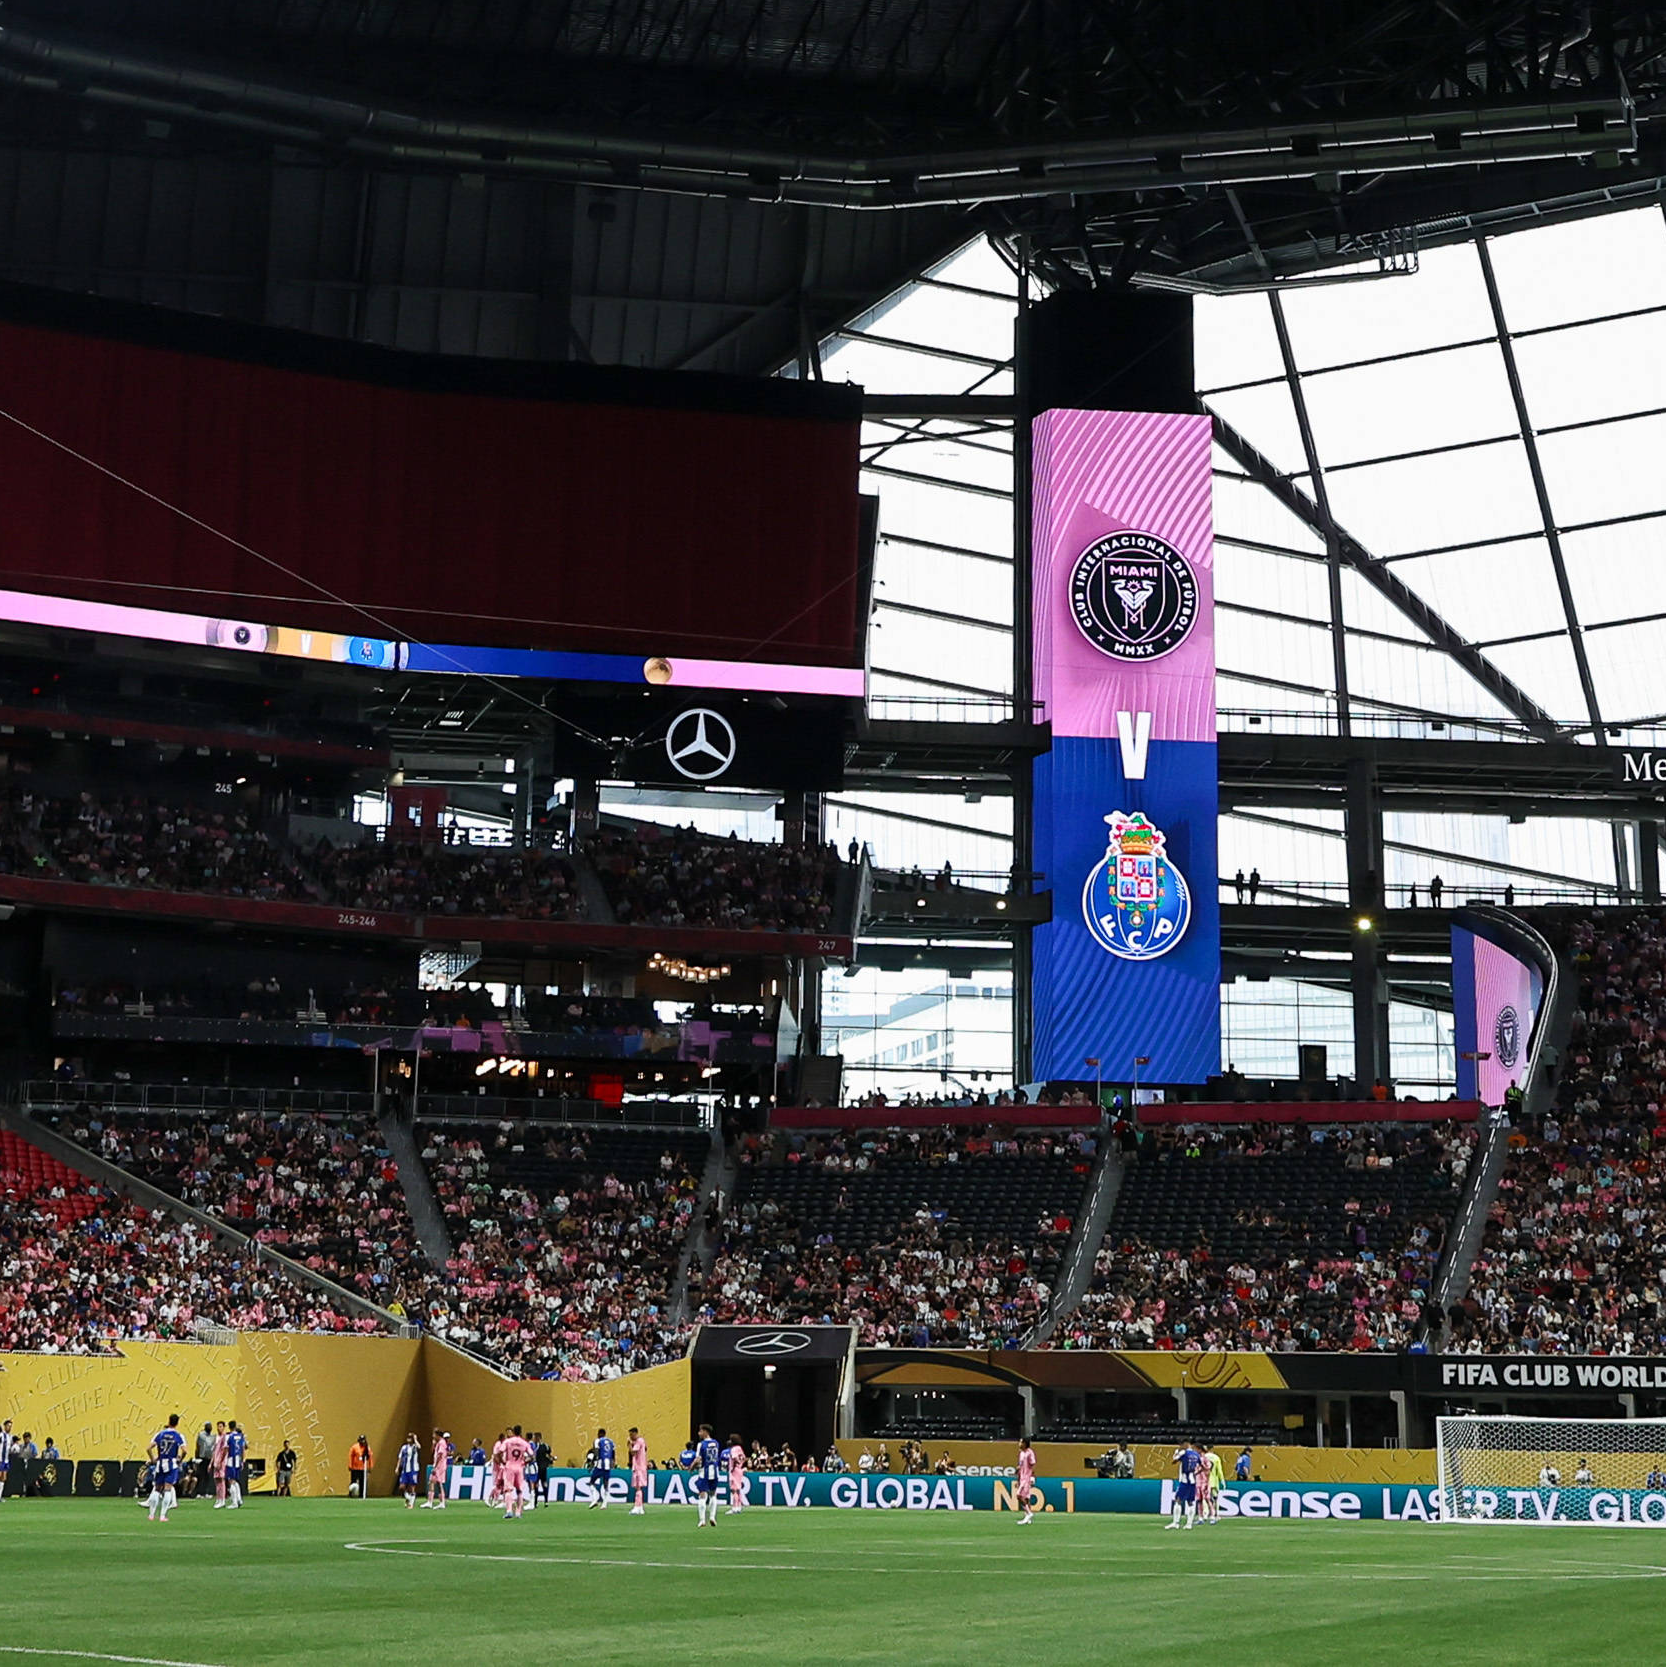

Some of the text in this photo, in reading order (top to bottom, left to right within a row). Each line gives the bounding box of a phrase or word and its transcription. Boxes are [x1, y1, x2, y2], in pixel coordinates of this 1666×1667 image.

[1075, 536, 1173, 587] INTERNACIONAL
[1109, 565, 1159, 578] MIAMI
[1173, 560, 1188, 579] DE
[1075, 593, 1093, 628] CLUB
[300, 633, 313, 655] V
[1113, 642, 1156, 656] MMXX
[1116, 710, 1153, 780] V
[215, 783, 233, 795] 245
[338, 914, 377, 927] 245-246
[1442, 1364, 1498, 1387] FIFA
[1503, 1365, 1570, 1388] CLUB
[159, 1438, 175, 1454] 97
[511, 1448, 522, 1460] 9
[759, 1475, 811, 1507] TV,
[830, 1477, 974, 1510] GLOBAL
[1160, 1480, 1361, 1520] Hsense
